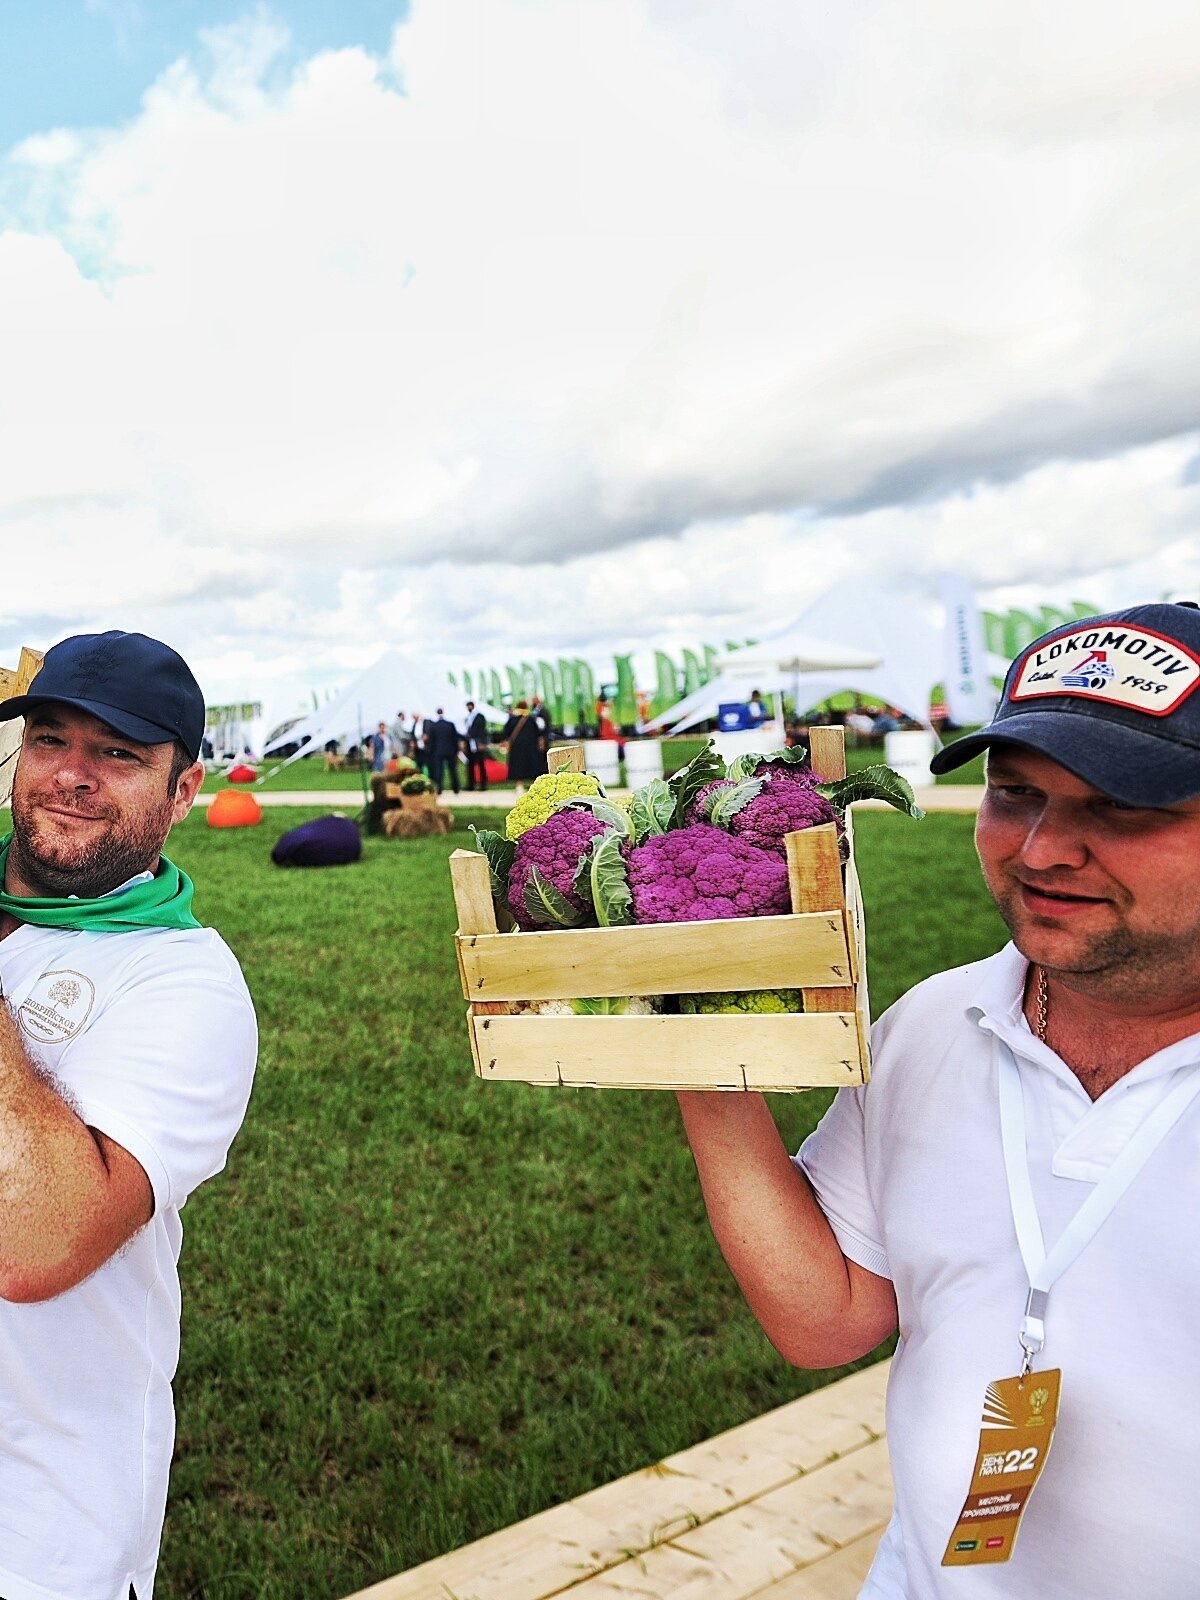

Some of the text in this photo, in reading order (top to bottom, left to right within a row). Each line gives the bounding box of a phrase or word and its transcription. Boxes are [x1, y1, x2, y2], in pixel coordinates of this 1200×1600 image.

[1035, 631, 1189, 677] LOKOMOTIV
[1121, 675, 1168, 695] 1959
[1003, 1447, 1038, 1473] 22
